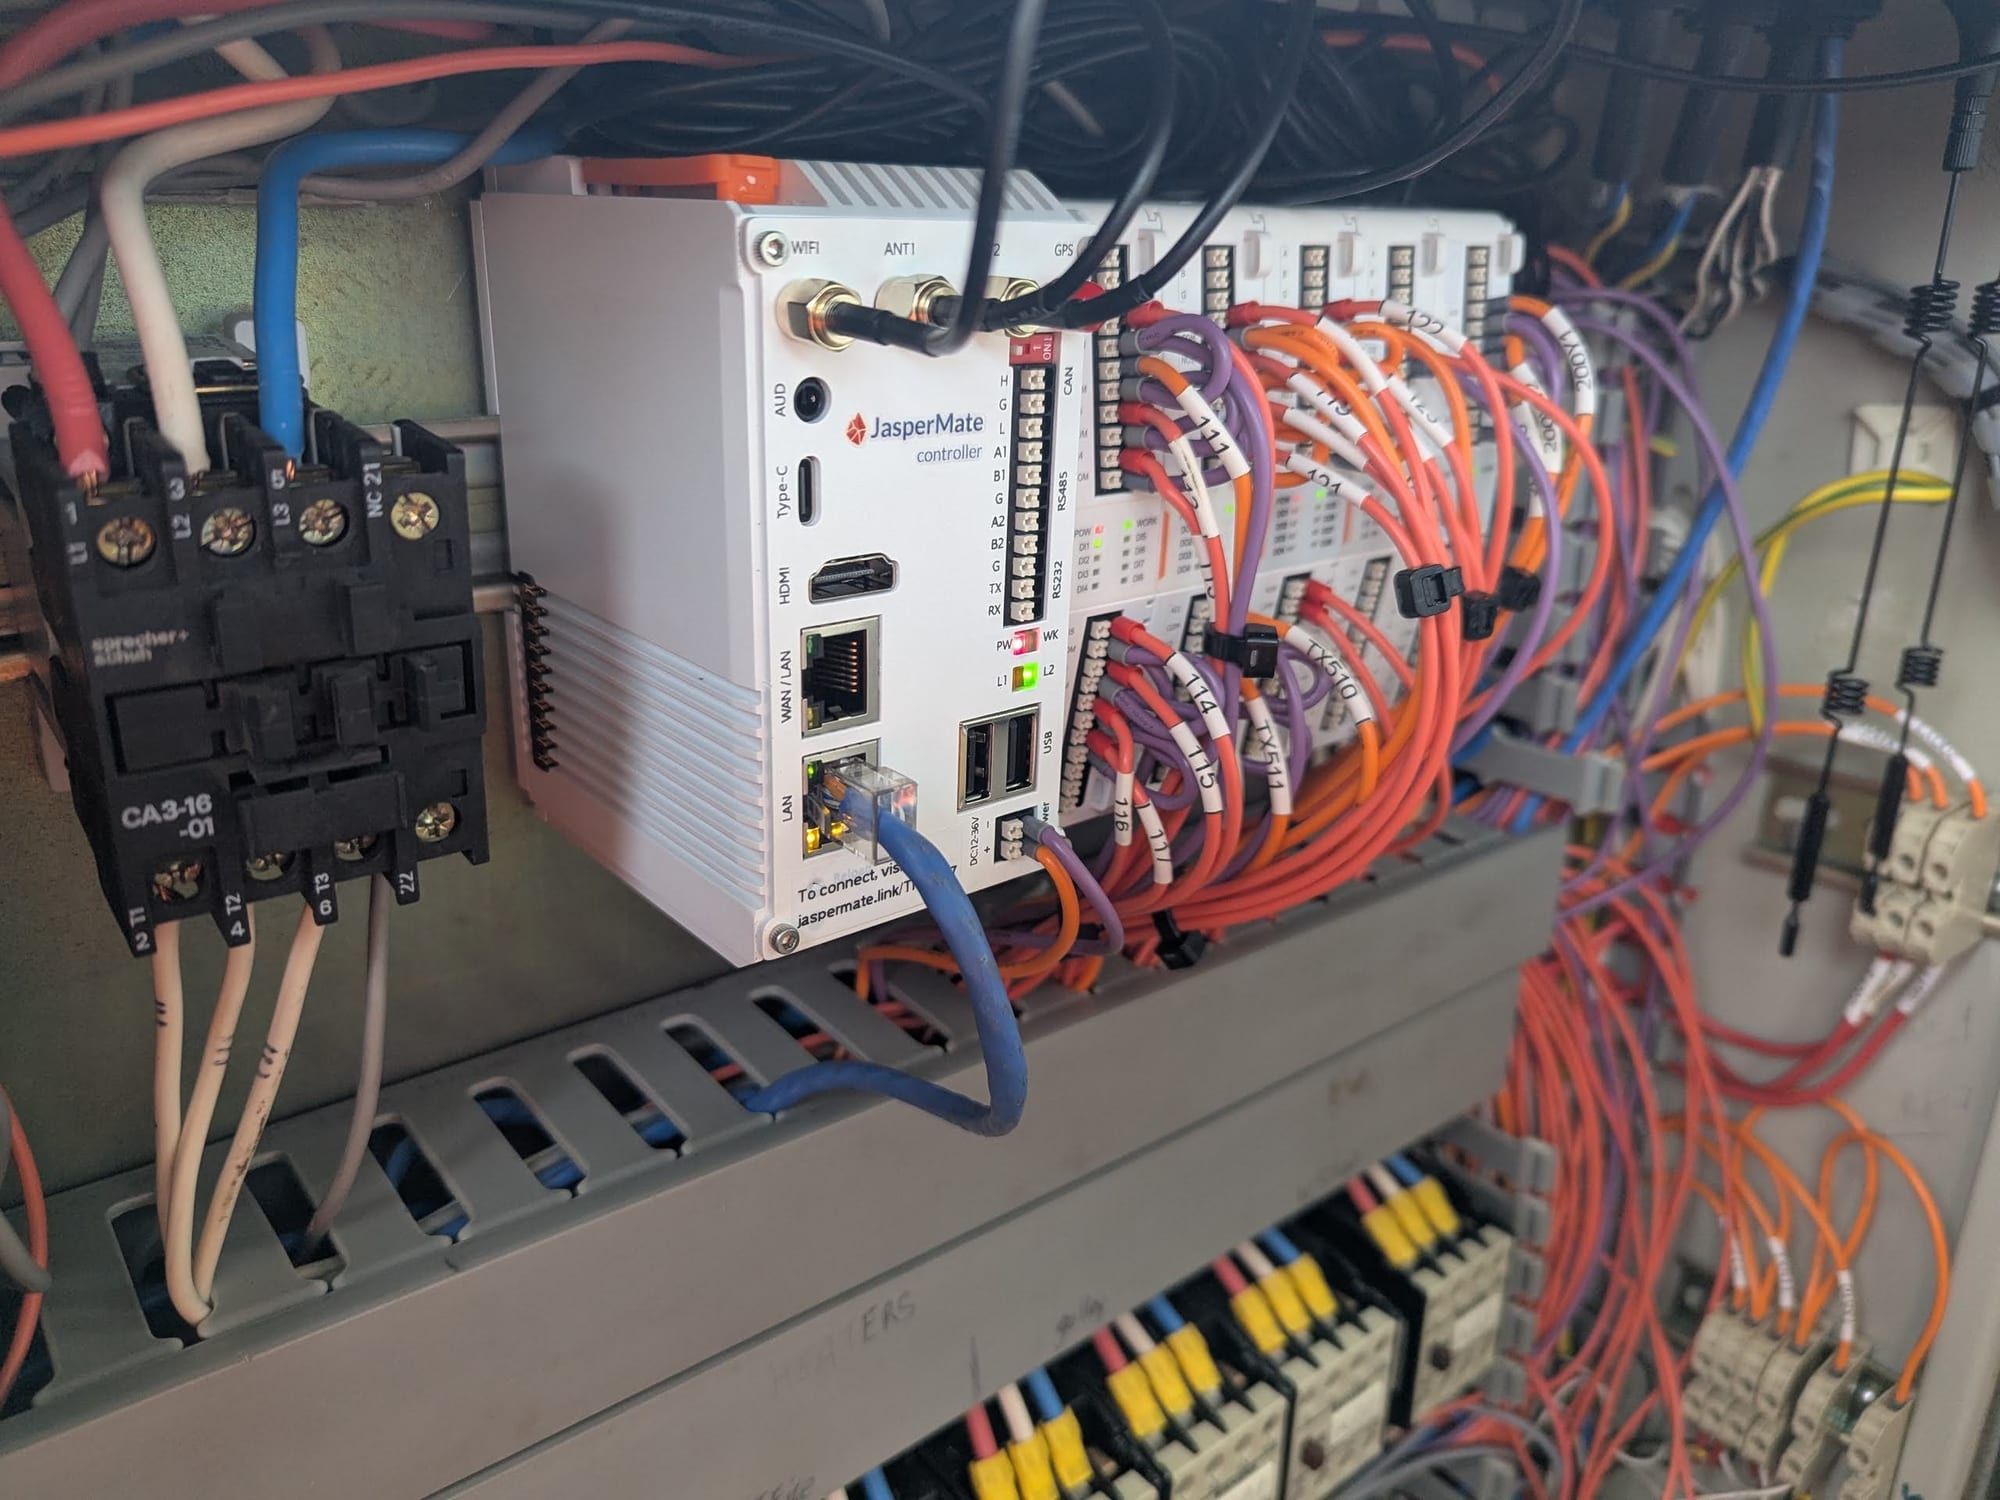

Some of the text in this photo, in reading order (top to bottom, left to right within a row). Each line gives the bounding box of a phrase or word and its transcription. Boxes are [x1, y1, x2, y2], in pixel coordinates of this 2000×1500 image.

[790, 241, 820, 255] WIFI
[884, 242, 915, 256] ANT1
[1054, 243, 1074, 257] GPS
[1406, 310, 1443, 335] 122
[1558, 331, 1592, 392] 200Y1
[1000, 375, 1008, 387] H
[1063, 366, 1073, 396] CAN
[774, 382, 787, 417] AUD
[999, 398, 1007, 411] G
[870, 412, 984, 441] JasperMate
[1000, 423, 1006, 435] L
[1199, 416, 1230, 454] 111
[917, 445, 983, 463] controller
[993, 446, 1007, 458] A1
[271, 469, 285, 489] 5
[993, 470, 1006, 482] B1
[169, 477, 185, 501] 3
[363, 462, 383, 519] NC 21
[776, 465, 790, 518] Type-C
[995, 492, 1004, 505] G
[1057, 471, 1068, 511] RS485
[65, 501, 78, 525] 1
[273, 502, 291, 526] L3
[991, 516, 1005, 528] A2
[1136, 517, 1157, 527] WORK
[171, 513, 192, 539] L2
[1074, 528, 1091, 537] POW
[991, 538, 1004, 550] B2
[1080, 543, 1089, 551] DI1
[992, 560, 1001, 573] G
[1079, 557, 1089, 565] DI2
[779, 567, 790, 604] HDMI
[989, 582, 1002, 594] TX
[1052, 560, 1062, 599] RS232
[1077, 585, 1088, 593] DI4
[988, 604, 1000, 616] RX
[997, 640, 1012, 652] PW
[1043, 630, 1058, 642] WK
[781, 650, 791, 674] LAN
[1043, 665, 1055, 676] L2
[1306, 638, 1358, 700] TX510
[997, 675, 1007, 687] L1
[1186, 673, 1217, 715] 114
[781, 689, 791, 724] WAN
[1043, 731, 1053, 754] USB
[1255, 719, 1284, 790] TX511
[1189, 745, 1215, 789] 115
[122, 794, 213, 829] CA3-16
[782, 794, 793, 822] LAN
[1116, 797, 1129, 831] 116
[179, 819, 215, 839] -01
[315, 872, 330, 894] T3
[400, 871, 415, 895] 22
[798, 889, 816, 903] To
[820, 868, 878, 897] connect,
[881, 862, 902, 877] vis
[225, 892, 241, 916] T2
[319, 900, 332, 916] 6
[129, 906, 146, 927] T1
[230, 920, 246, 937] 4
[136, 932, 151, 951] 2
